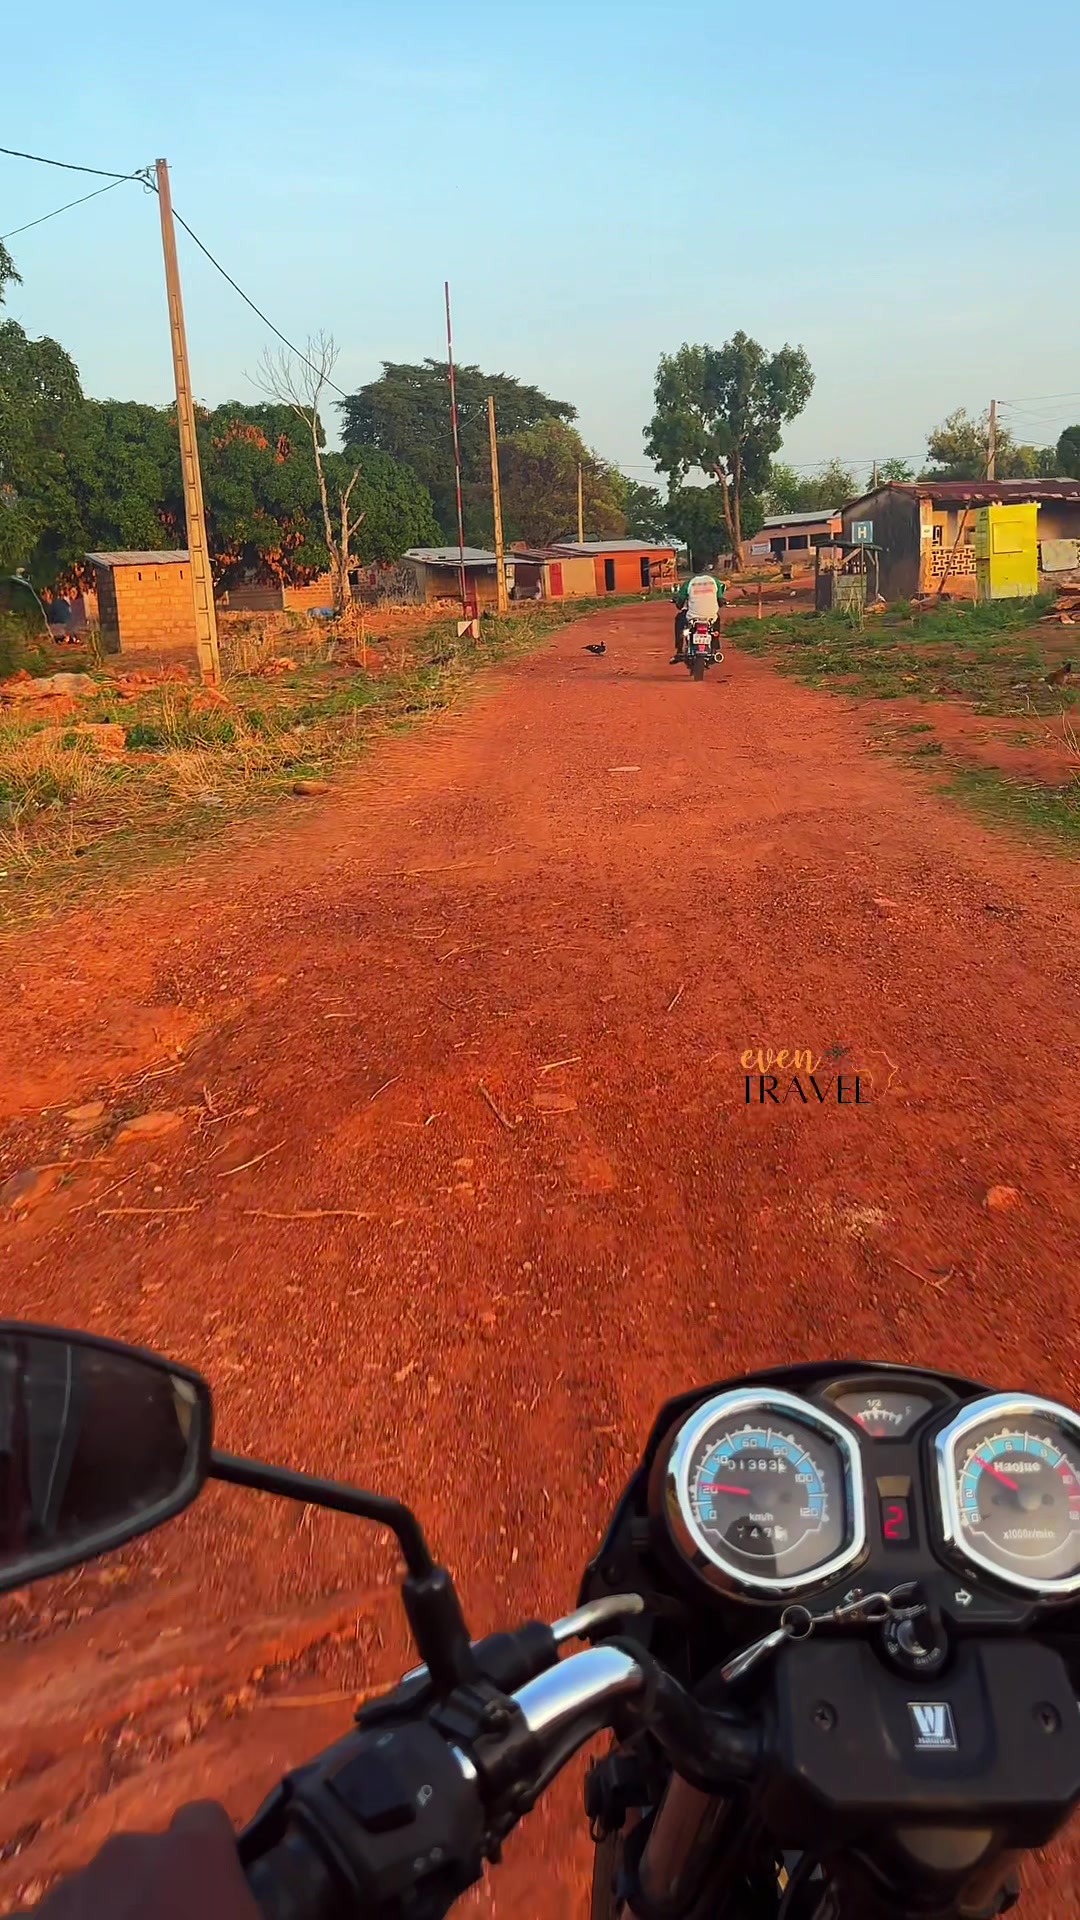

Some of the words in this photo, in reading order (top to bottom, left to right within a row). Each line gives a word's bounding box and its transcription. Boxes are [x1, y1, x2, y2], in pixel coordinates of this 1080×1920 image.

[857, 526, 867, 539] H
[867, 1399, 882, 1407] 1/2
[742, 1438, 758, 1448] 60
[773, 1446, 788, 1456] 80
[713, 1455, 728, 1464] 40
[993, 1461, 1041, 1473] Haojue
[794, 1473, 813, 1483] 100
[702, 1485, 718, 1494] 20
[966, 1488, 974, 1498] 2
[708, 1510, 717, 1520] 0
[748, 1512, 774, 1521] km/h
[799, 1507, 818, 1517] 120
[884, 1506, 905, 1538] 2
